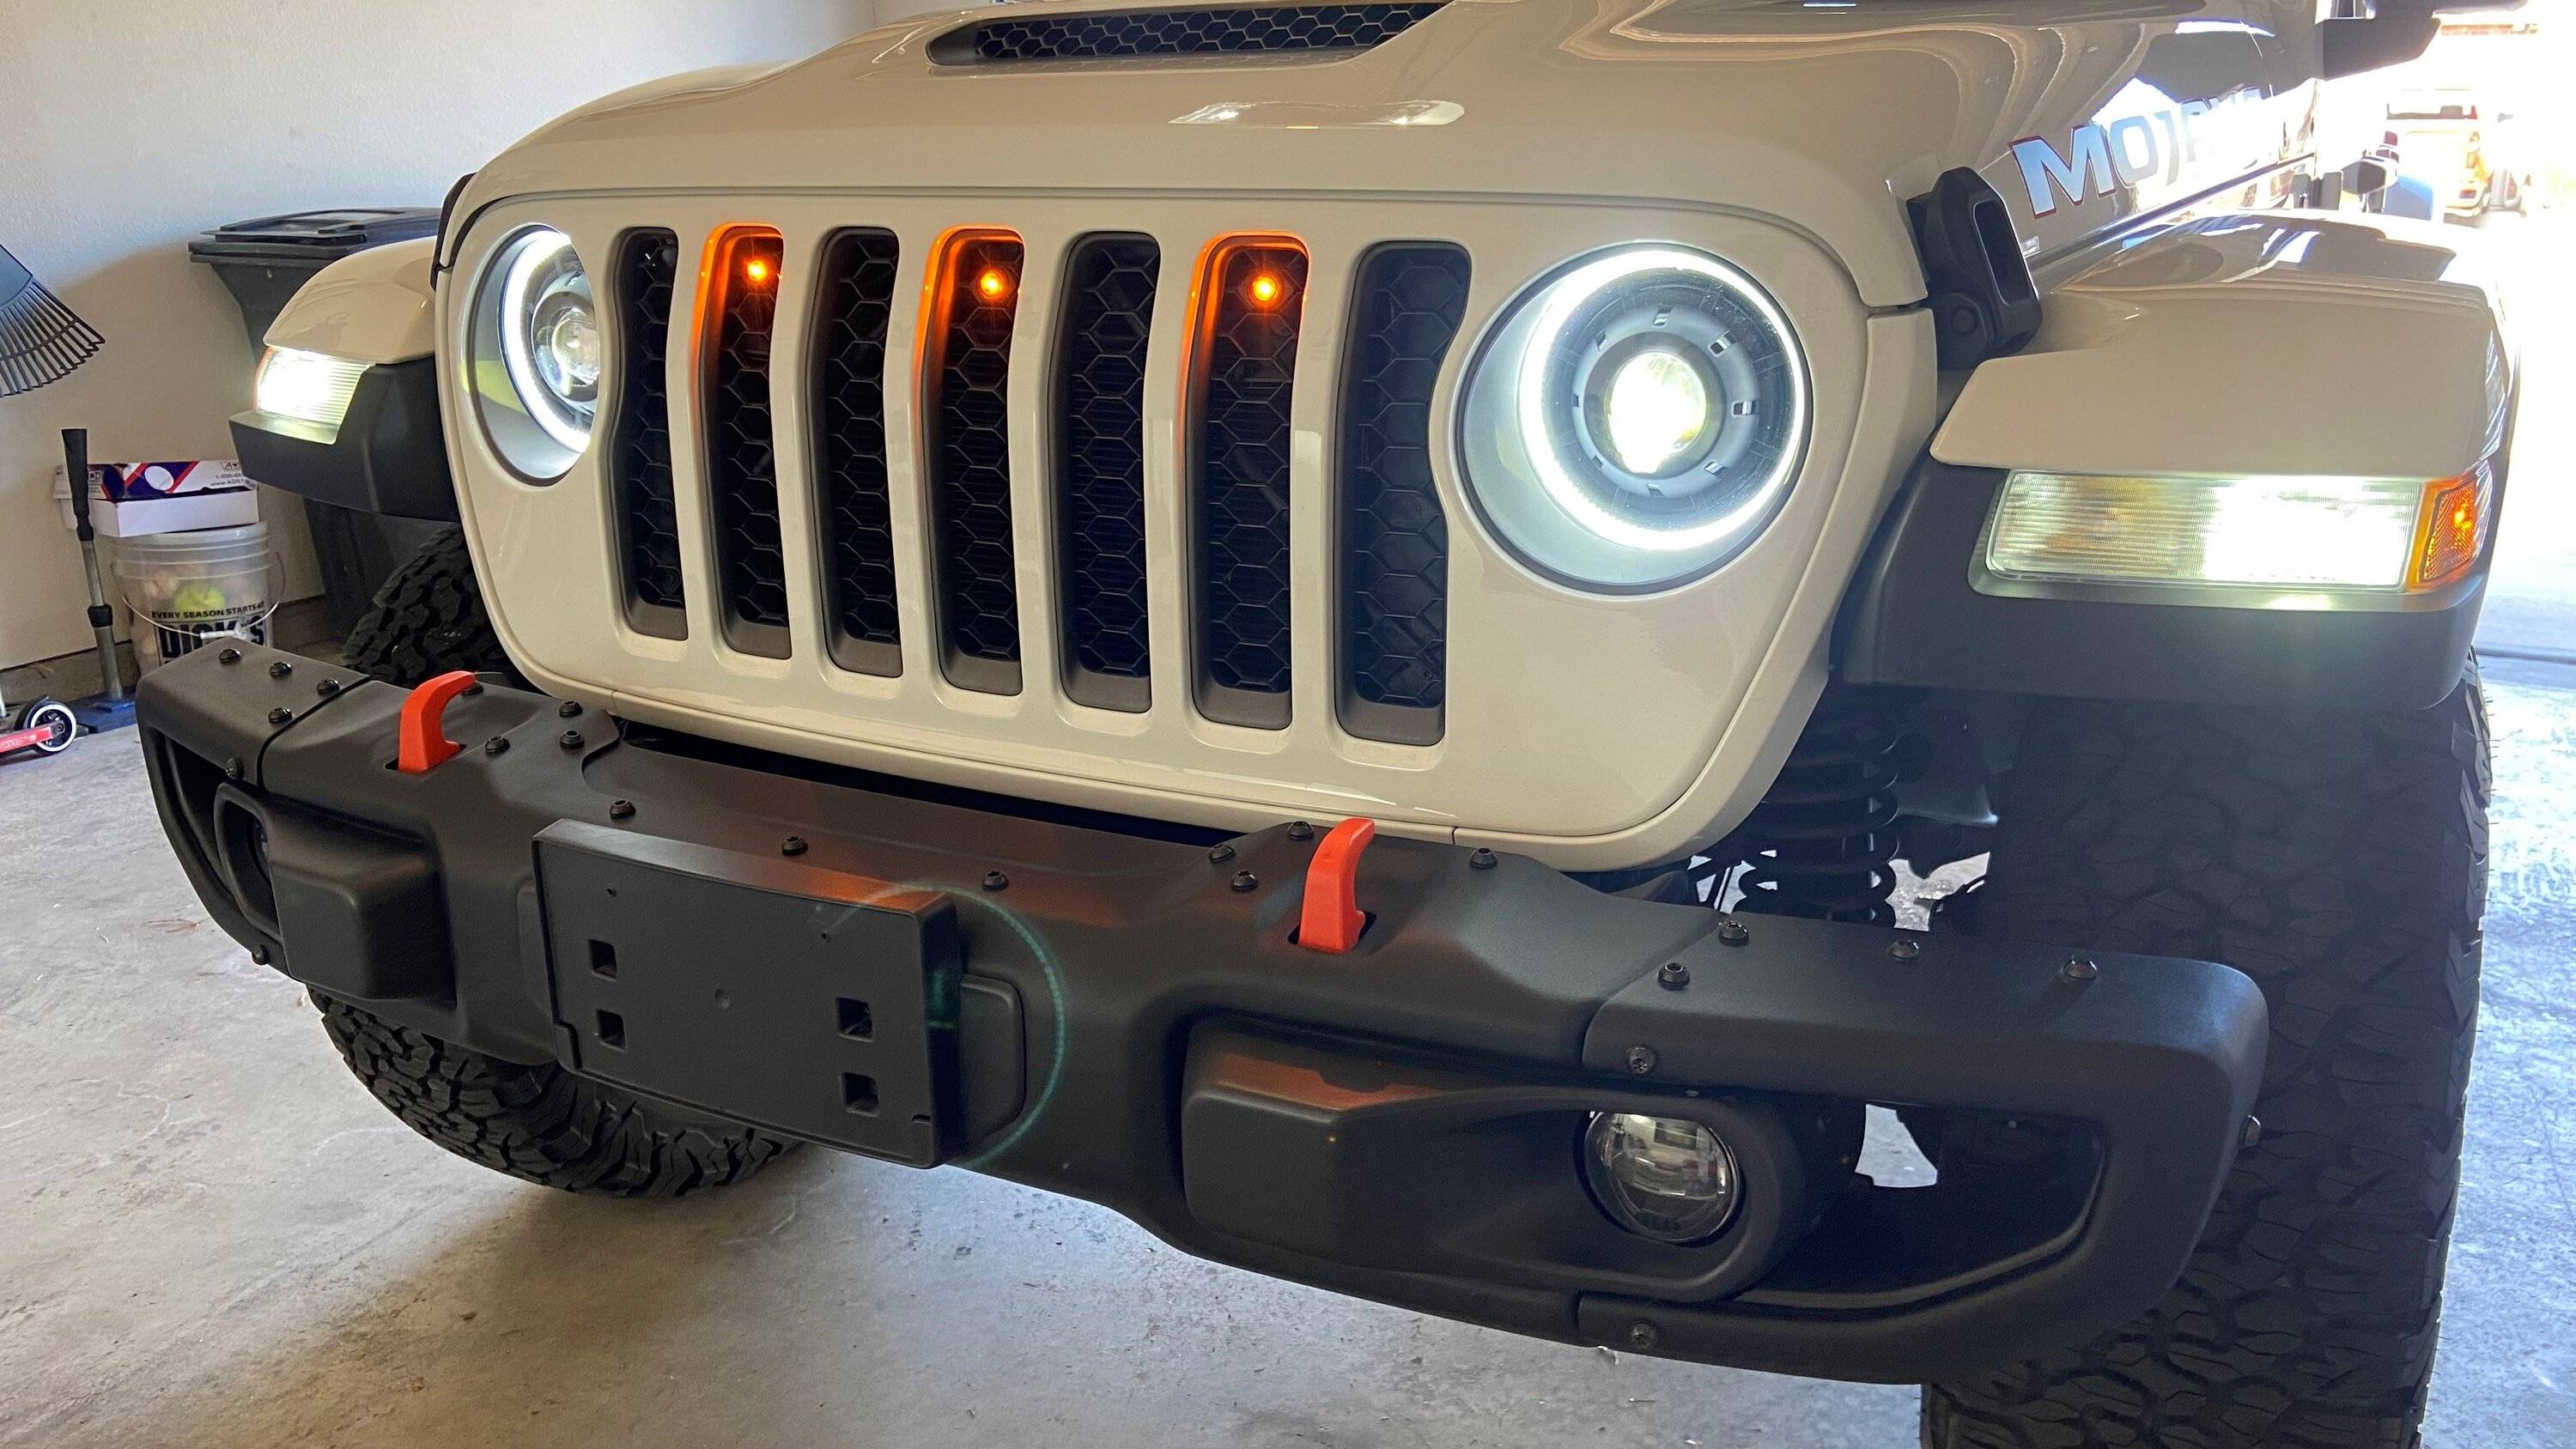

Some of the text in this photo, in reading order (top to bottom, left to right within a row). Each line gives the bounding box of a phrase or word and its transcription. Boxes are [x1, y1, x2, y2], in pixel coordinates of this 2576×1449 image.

[2007, 86, 2264, 220] MOJ
[183, 609, 224, 619] SEASON
[226, 603, 256, 615] STARTS
[158, 615, 264, 658] DICS
